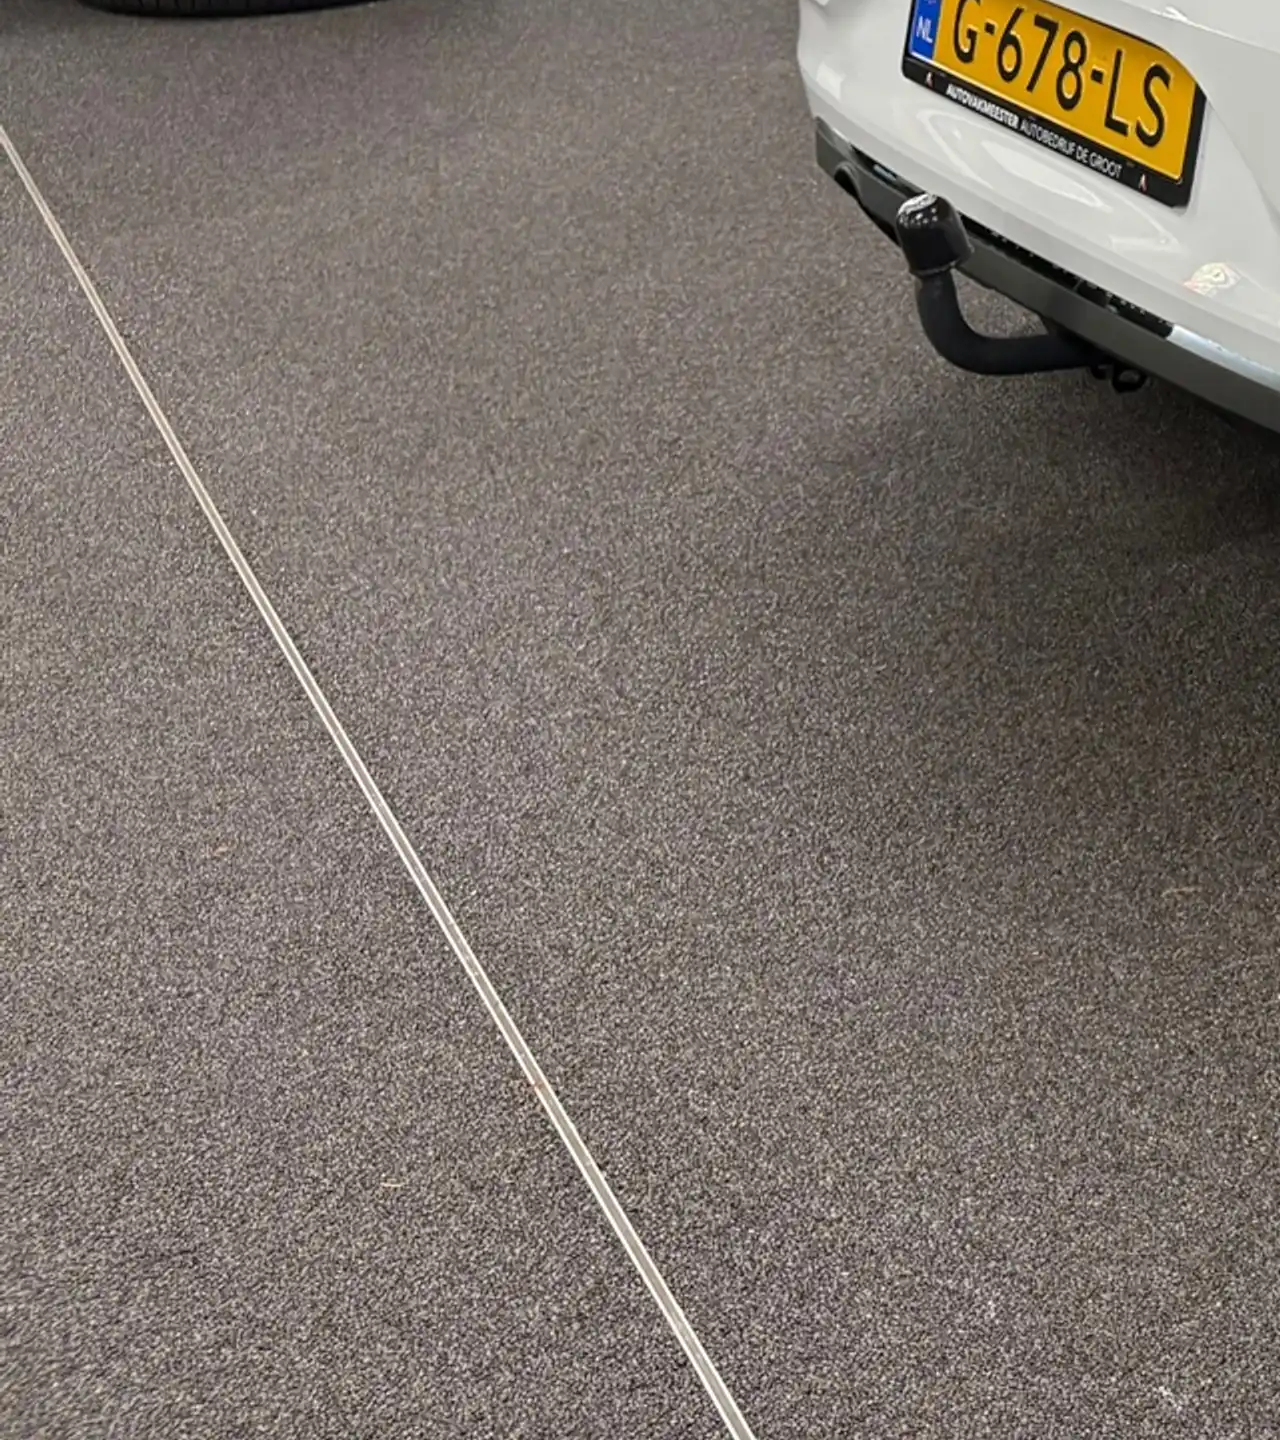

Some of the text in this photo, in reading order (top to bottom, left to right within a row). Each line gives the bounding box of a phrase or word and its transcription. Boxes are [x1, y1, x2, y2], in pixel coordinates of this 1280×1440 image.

[916, 15, 934, 45] NL
[945, 82, 1124, 180] AUTOVAKMEESTER AUTOBEDRIJF DE GROOT
